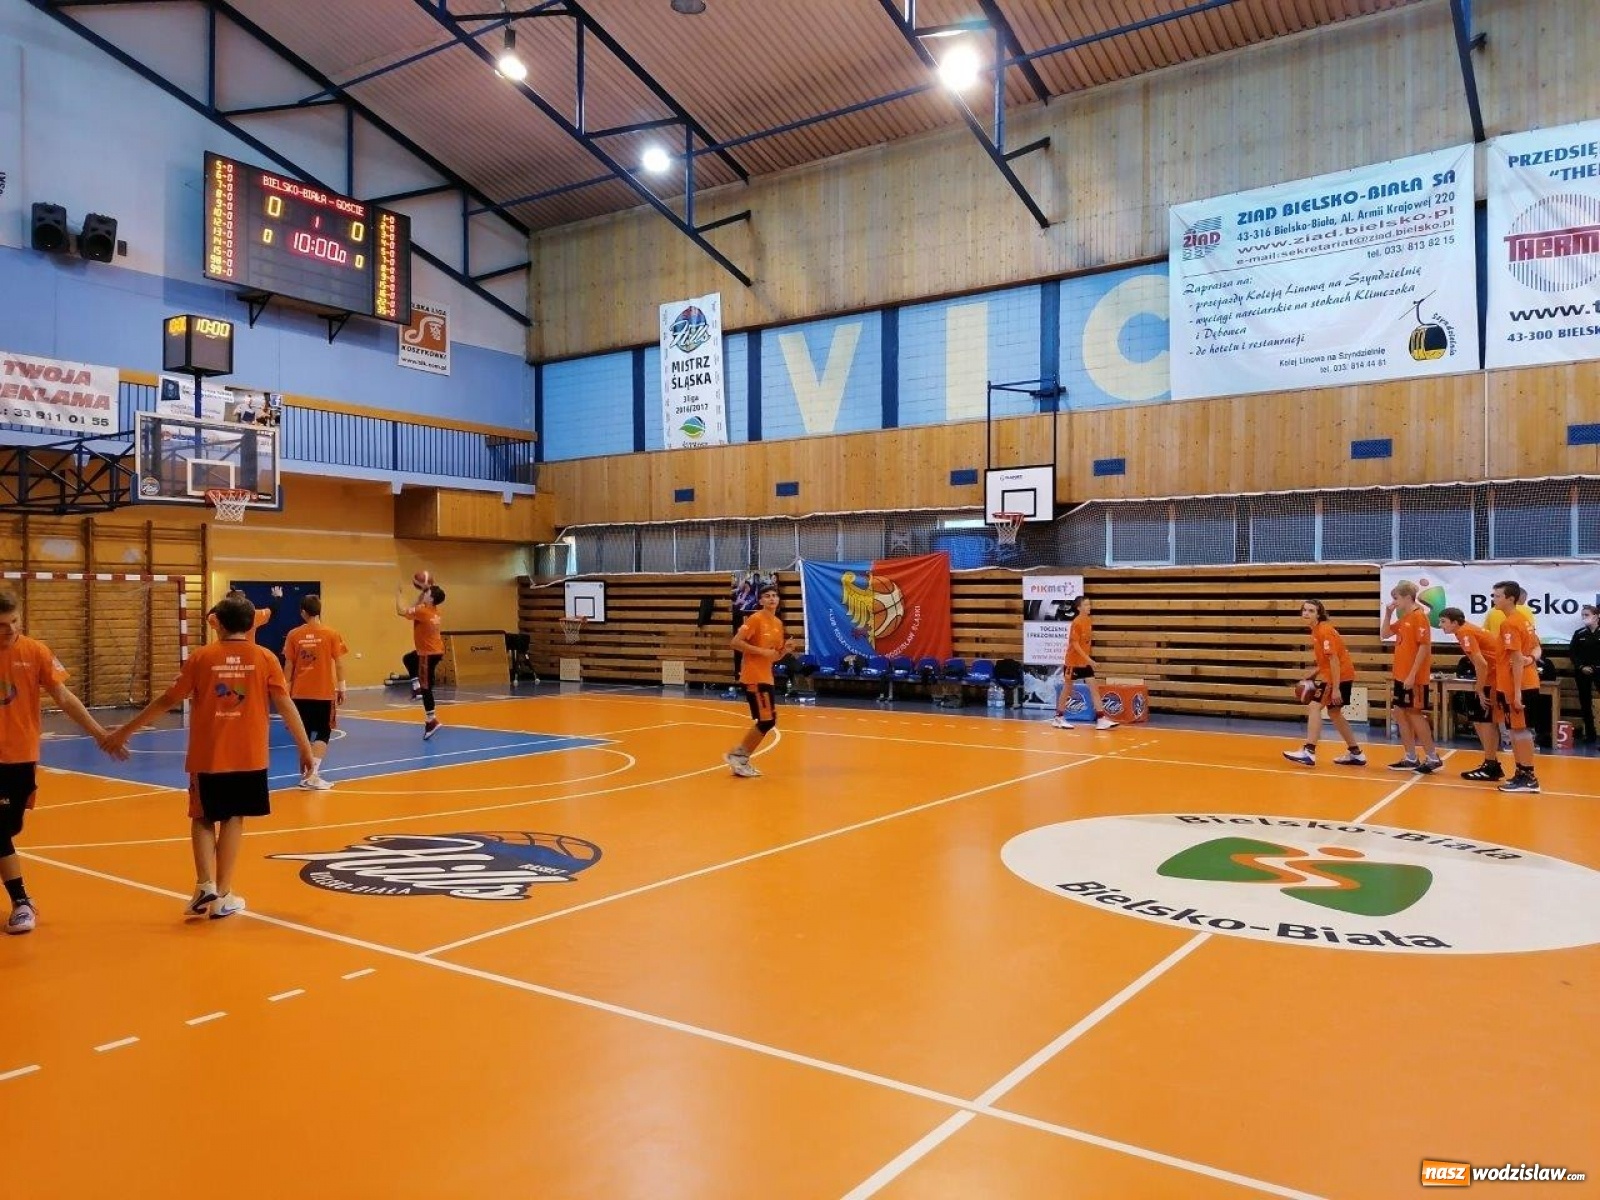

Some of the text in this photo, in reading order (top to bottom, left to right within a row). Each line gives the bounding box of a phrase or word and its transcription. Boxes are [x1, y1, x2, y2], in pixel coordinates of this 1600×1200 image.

[1549, 164, 1600, 182] "THE
[268, 195, 281, 217] 0
[1237, 169, 1455, 225] ZIAD BIELSKO-BIAŁA SA
[1237, 227, 1271, 241] 43-316
[1341, 211, 1354, 223] Al.
[1358, 206, 1383, 220] Armii
[1387, 197, 1431, 214] Krajowej
[1434, 191, 1455, 205] 220
[263, 228, 273, 243] 0
[351, 221, 364, 242] 0
[1238, 205, 1454, 254] www.ziad.bielsko.pl
[1183, 231, 1221, 248] ZIAD
[1408, 241, 1425, 251] 813
[1444, 235, 1455, 245] 15
[355, 254, 364, 268] 0
[1183, 280, 1233, 296] Zaprasza
[1328, 280, 1342, 289] na
[1294, 303, 1307, 311] na
[1310, 291, 1351, 308] stokach
[1354, 282, 1416, 301] Klimczoka
[196, 319, 231, 337] 10:00
[1508, 329, 1554, 342] 43-300
[4, 360, 91, 386] TWOJA
[671, 355, 711, 373] MISTRZ
[671, 371, 712, 391] ŚLĄSKA
[0, 382, 110, 410] EKLAMA
[14, 408, 31, 419] 33
[69, 414, 85, 425] 01
[92, 417, 109, 427] 55
[1055, 886, 1452, 949] Bielsko-Biała
